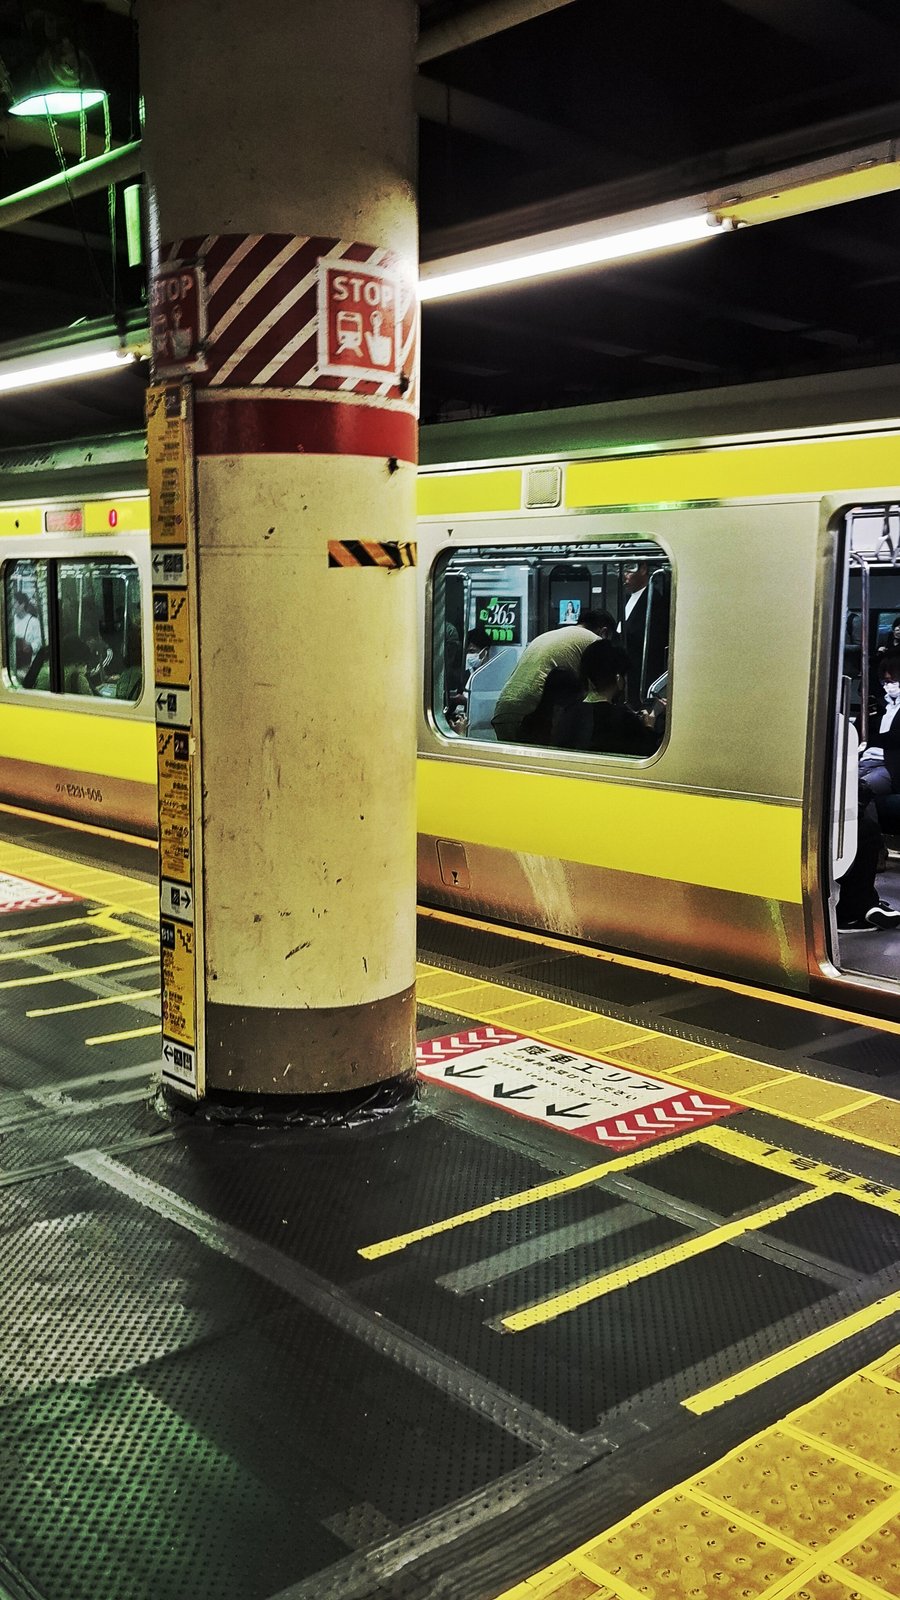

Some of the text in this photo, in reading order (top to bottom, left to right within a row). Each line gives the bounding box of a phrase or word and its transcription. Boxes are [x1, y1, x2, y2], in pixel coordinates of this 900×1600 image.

[333, 276, 393, 309] STOP
[488, 603, 516, 625] 365
[517, 1045, 665, 1091] 降車エリア
[761, 1147, 900, 1203] 1号車乗
